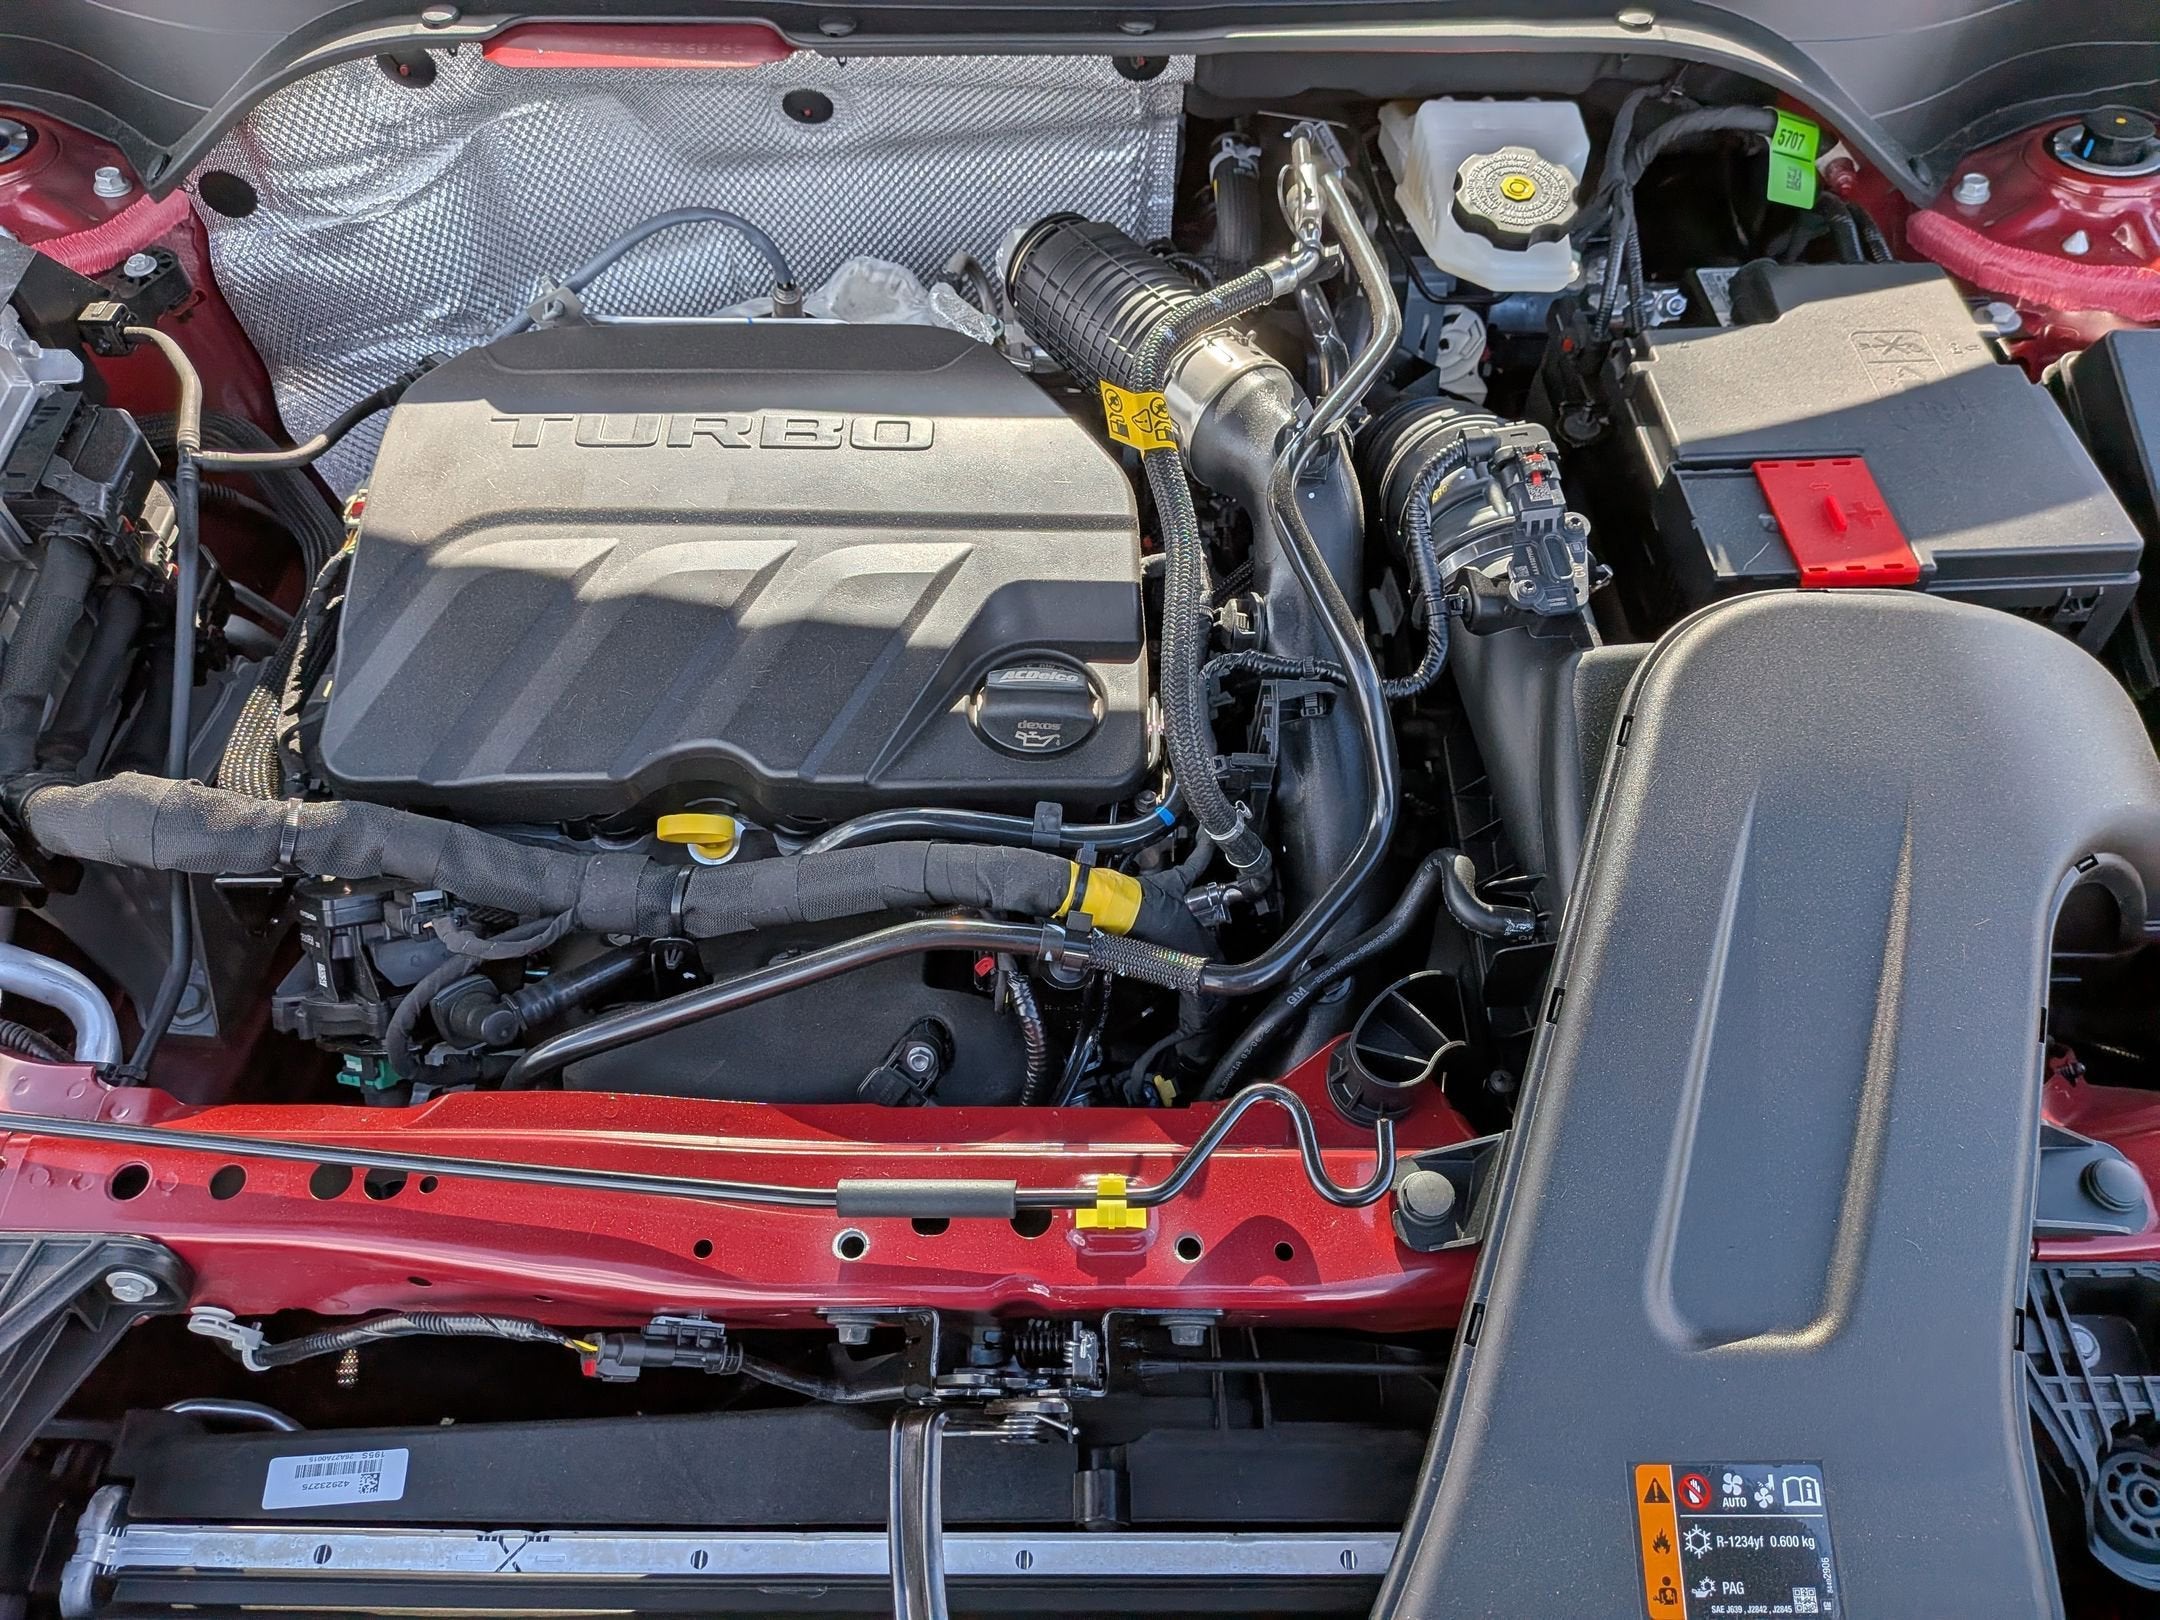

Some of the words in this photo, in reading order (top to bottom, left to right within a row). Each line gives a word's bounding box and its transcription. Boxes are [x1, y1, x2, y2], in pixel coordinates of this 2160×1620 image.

[1777, 128, 1806, 152] 5707
[490, 414, 935, 451] TURBO
[999, 670, 1079, 682] ACDelco
[1017, 720, 1061, 731] dexos
[1286, 986, 1310, 1008] GM
[362, 1451, 385, 1459] 195S
[302, 1480, 350, 1490] 42923275
[1722, 1497, 1747, 1508] AUTO
[1716, 1536, 1764, 1550] R-1234yf
[1769, 1535, 1800, 1548] 0.600
[1801, 1535, 1816, 1550] kg
[1722, 1581, 1745, 1595] PAG
[1711, 1605, 1725, 1614] SAE
[1772, 1605, 1793, 1614] J2845
